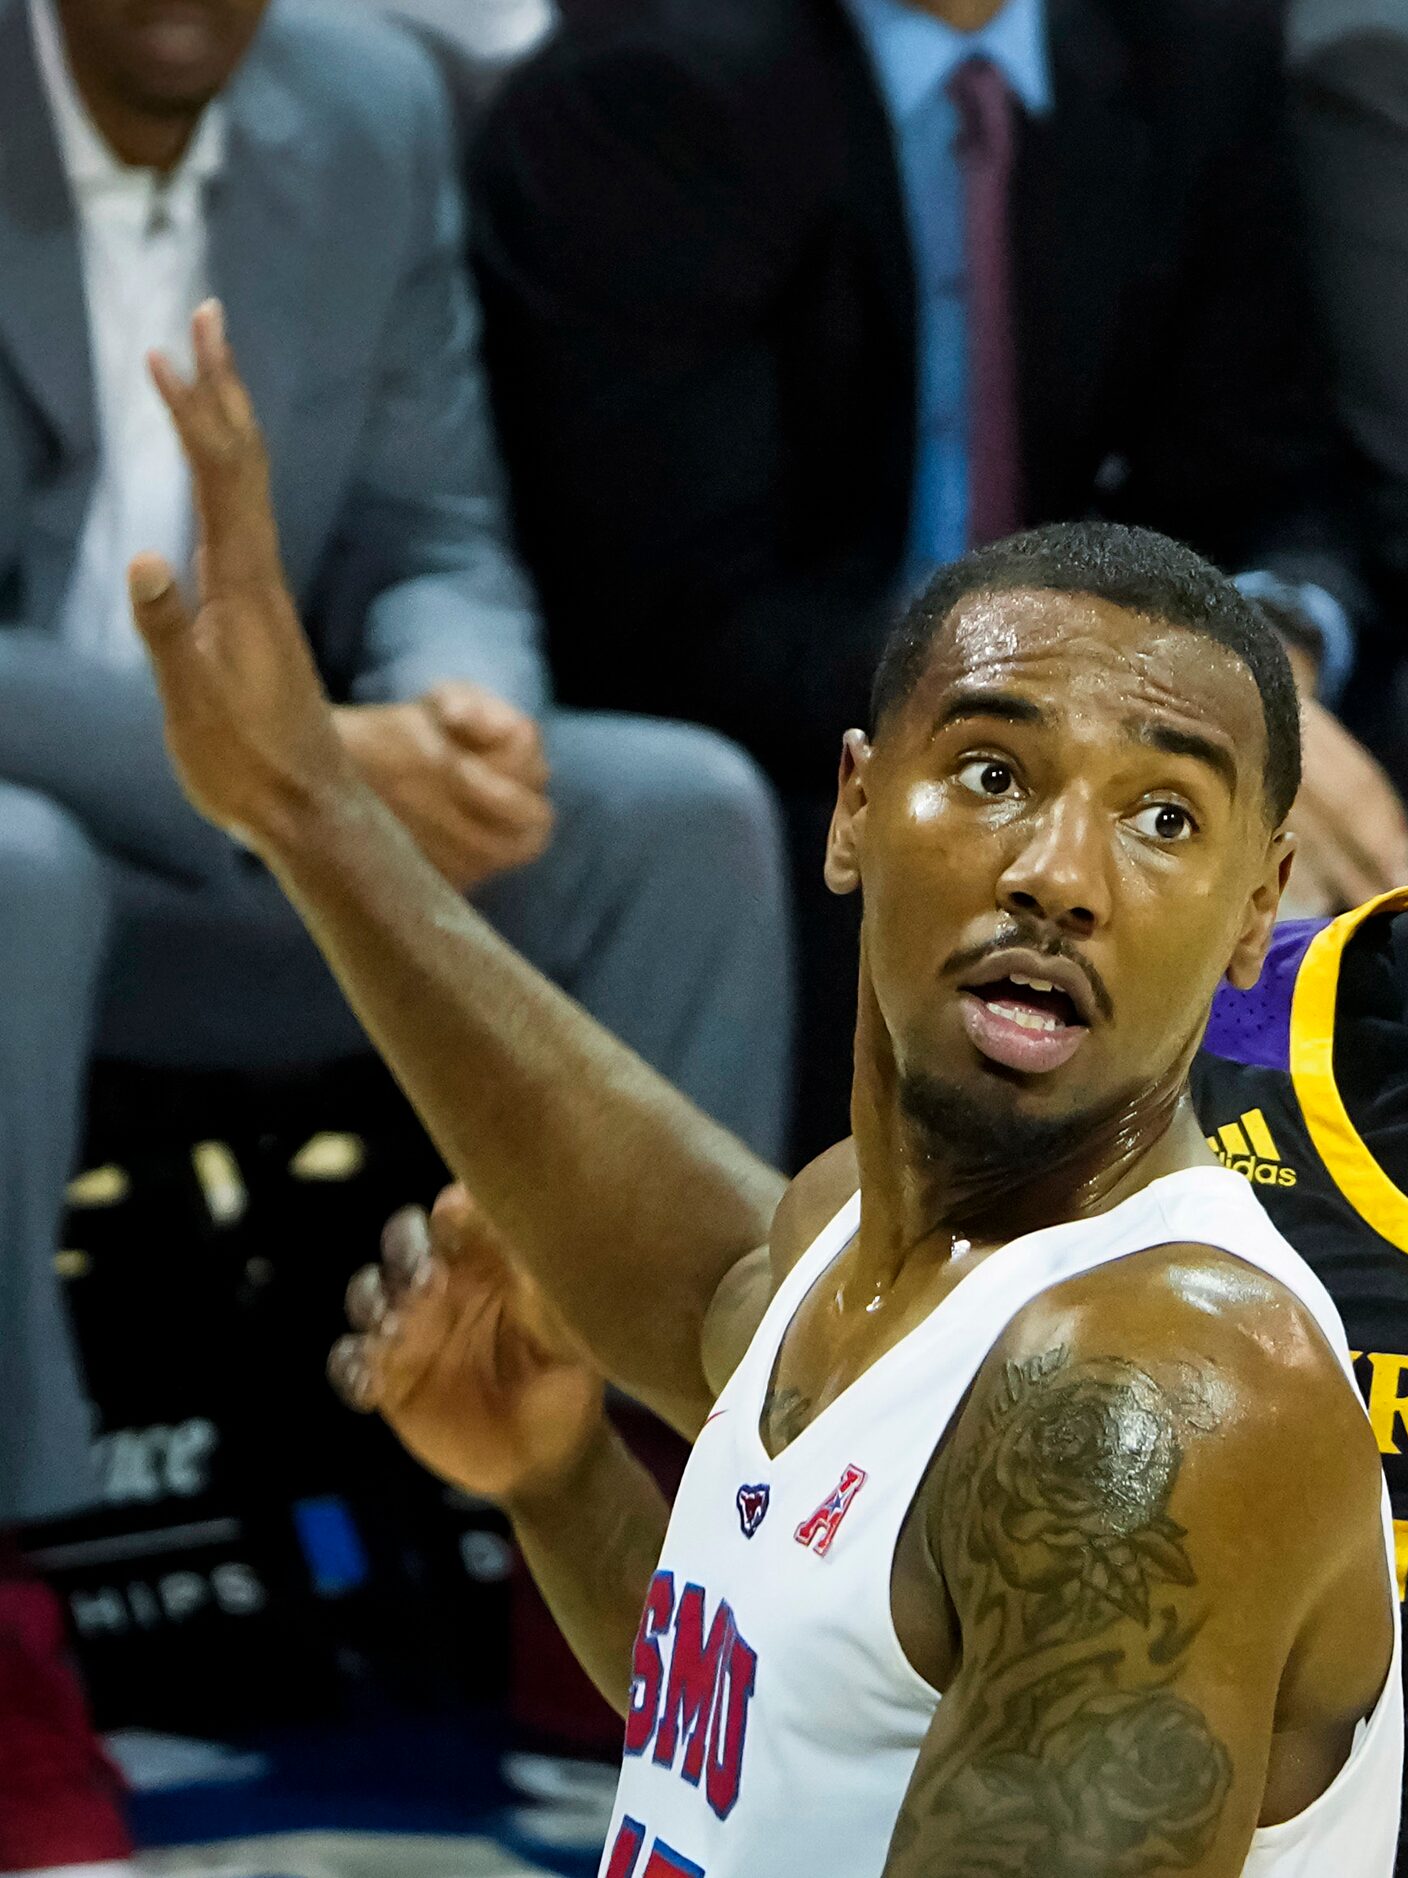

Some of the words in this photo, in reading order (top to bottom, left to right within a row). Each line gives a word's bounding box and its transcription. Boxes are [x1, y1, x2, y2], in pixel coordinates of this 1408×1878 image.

[1219, 1151, 1297, 1187] idas
[794, 1463, 867, 1557] A
[624, 1570, 757, 1821] SMU
